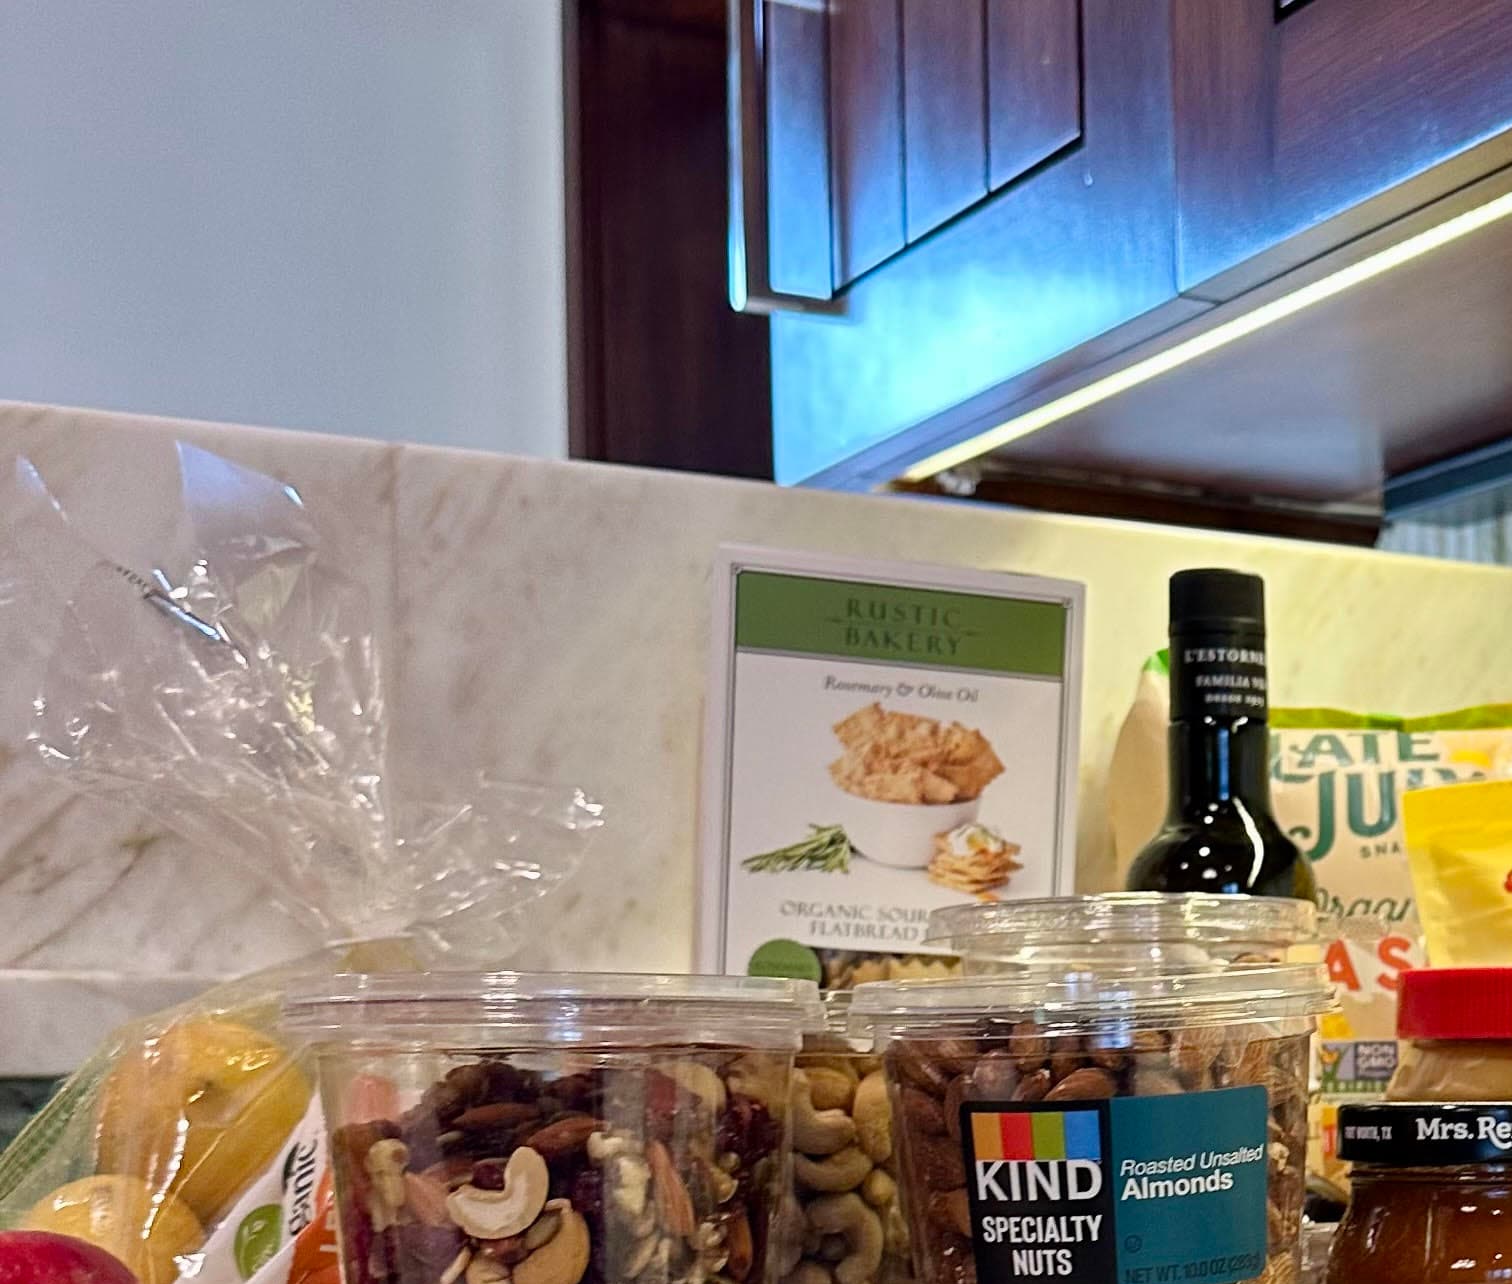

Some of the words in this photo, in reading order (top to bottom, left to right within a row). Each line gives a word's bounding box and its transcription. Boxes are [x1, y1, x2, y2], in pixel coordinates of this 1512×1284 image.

[845, 598, 961, 628] RUSTIC
[844, 626, 962, 656] BAKERY
[824, 675, 893, 698] Rosemary
[895, 683, 914, 698] &
[919, 684, 953, 701] Olive
[956, 687, 979, 703] Oil
[1269, 732, 1440, 784] LATE
[1360, 844, 1401, 859] SNA
[779, 899, 873, 926] ORGANIC
[875, 904, 931, 926] SOUR
[809, 920, 919, 942] FLATBREAD
[1416, 1117, 1474, 1140] Mrs.
[1120, 1154, 1196, 1177] Roasted
[1200, 1143, 1264, 1168] Unsalted
[289, 1137, 319, 1237] ganic
[975, 1160, 1103, 1202] KIND
[1120, 1170, 1235, 1202] Almonds
[981, 1214, 1103, 1244] SPECIALTY
[1012, 1249, 1073, 1277] NUTS
[1125, 1268, 1153, 1284] NET
